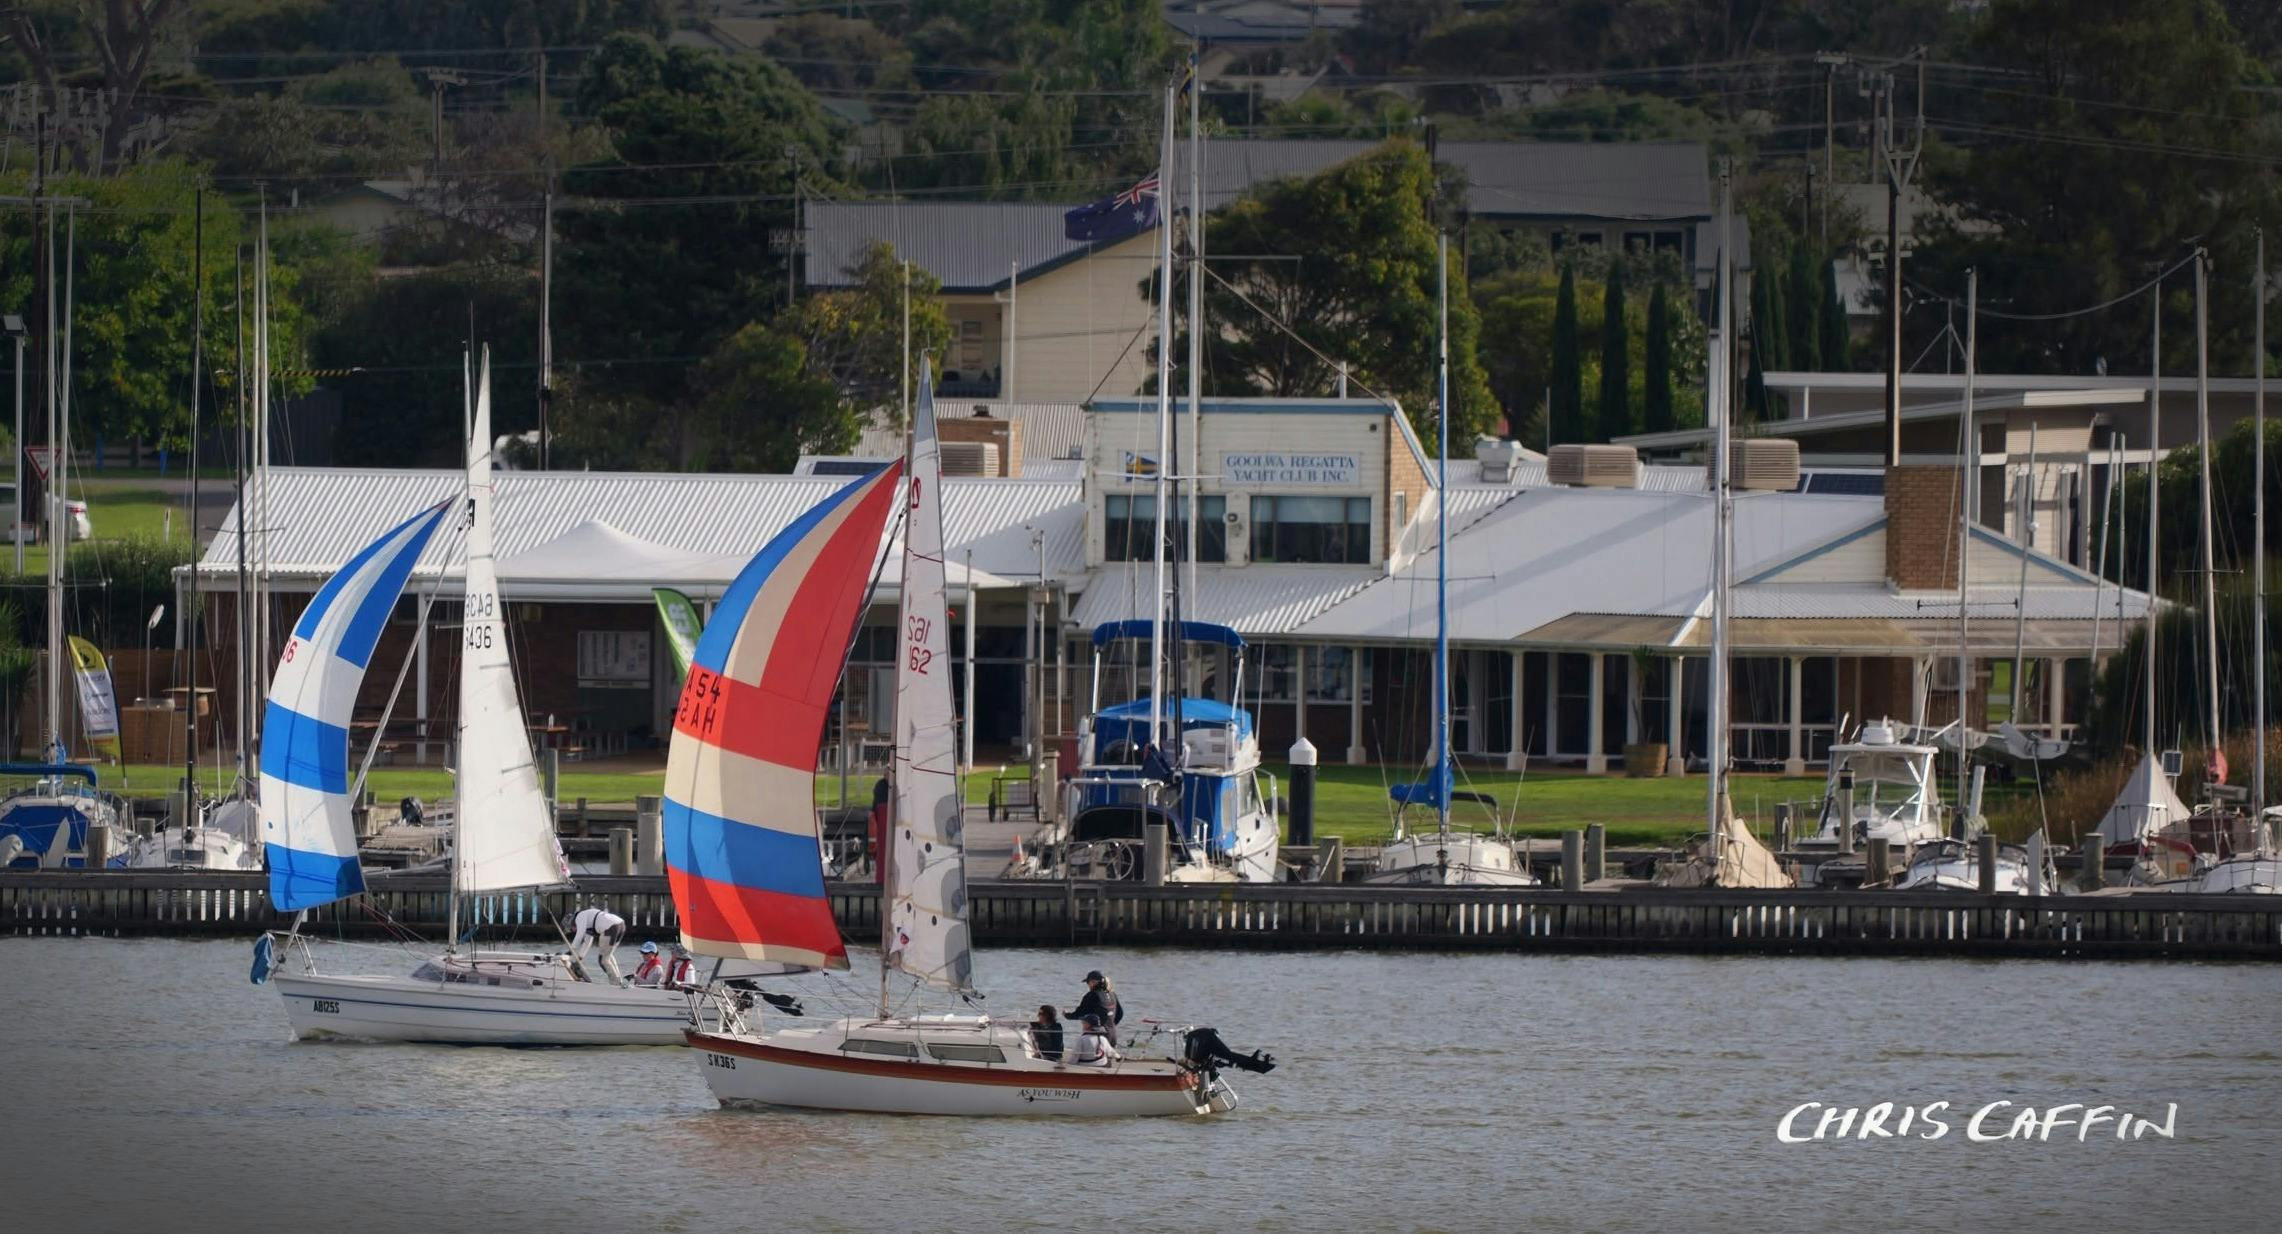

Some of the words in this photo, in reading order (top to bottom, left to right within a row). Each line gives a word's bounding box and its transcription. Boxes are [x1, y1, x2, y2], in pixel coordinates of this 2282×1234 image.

[1226, 455, 1284, 468] GOOLWA
[1290, 455, 1354, 469] REGATTA
[1234, 469, 1276, 482] YACHT
[1279, 470, 1317, 482] CLUB
[1032, 1088, 1052, 1097] YOU
[1054, 1089, 1081, 1099] WISH
